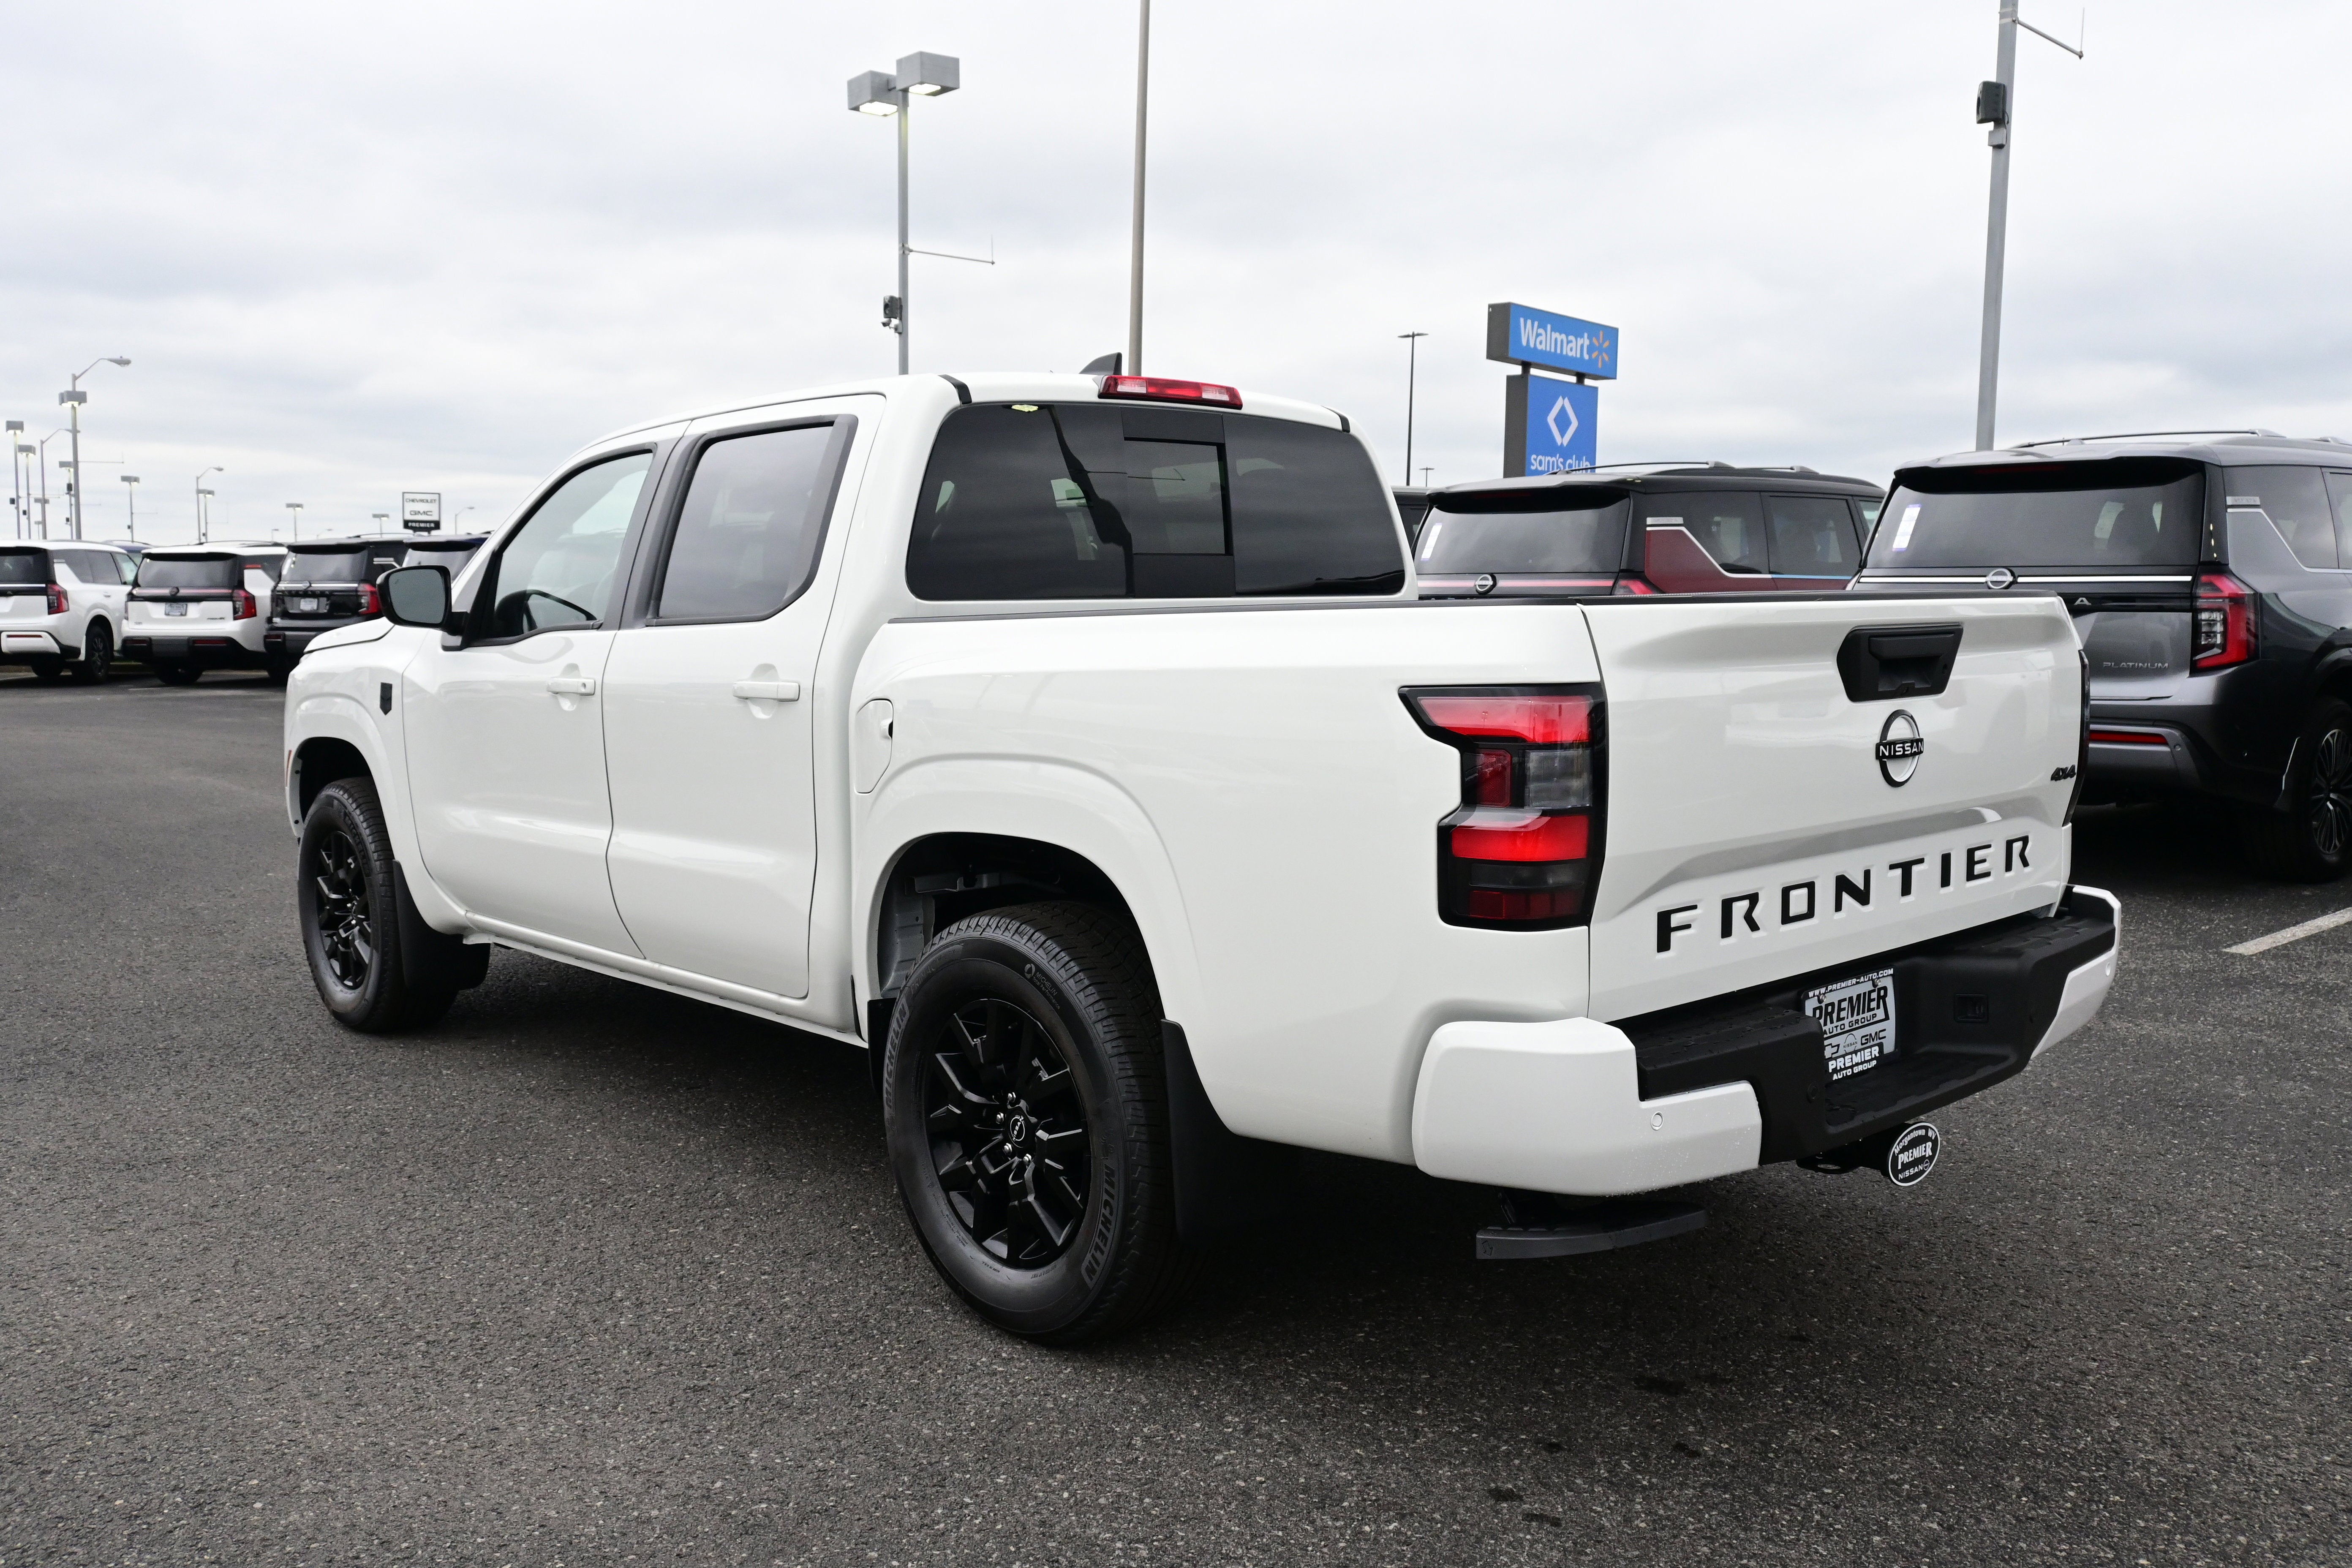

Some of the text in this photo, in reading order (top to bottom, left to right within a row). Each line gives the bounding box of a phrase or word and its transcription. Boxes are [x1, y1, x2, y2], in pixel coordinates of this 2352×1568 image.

[1520, 317, 1590, 359] Walmart
[1530, 454, 1590, 473] sam's club
[1880, 741, 1923, 757] NISSAN
[1656, 835, 2030, 954] FRONTIER
[1035, 972, 1058, 996] MICHELIN
[1808, 968, 1893, 997] WWW.PREMIER-AUTO.COM
[1040, 984, 1061, 1010] Performance
[1812, 985, 1890, 1027] PREMIER
[1824, 1013, 1877, 1036] AUTO GROUP
[1861, 1029, 1886, 1045] GMC
[885, 1002, 908, 1110] MICHELIN
[1828, 1045, 1879, 1073] PREMIER
[1832, 1060, 1877, 1081] AUTO GROUP
[1012, 1115, 1024, 1142] NISSAN
[1894, 1128, 1936, 1156] Morgantown WV
[1898, 1141, 1932, 1169] PREMIER
[1898, 1163, 1923, 1180] NISSAN
[1085, 1163, 1116, 1282] MICHELIN
